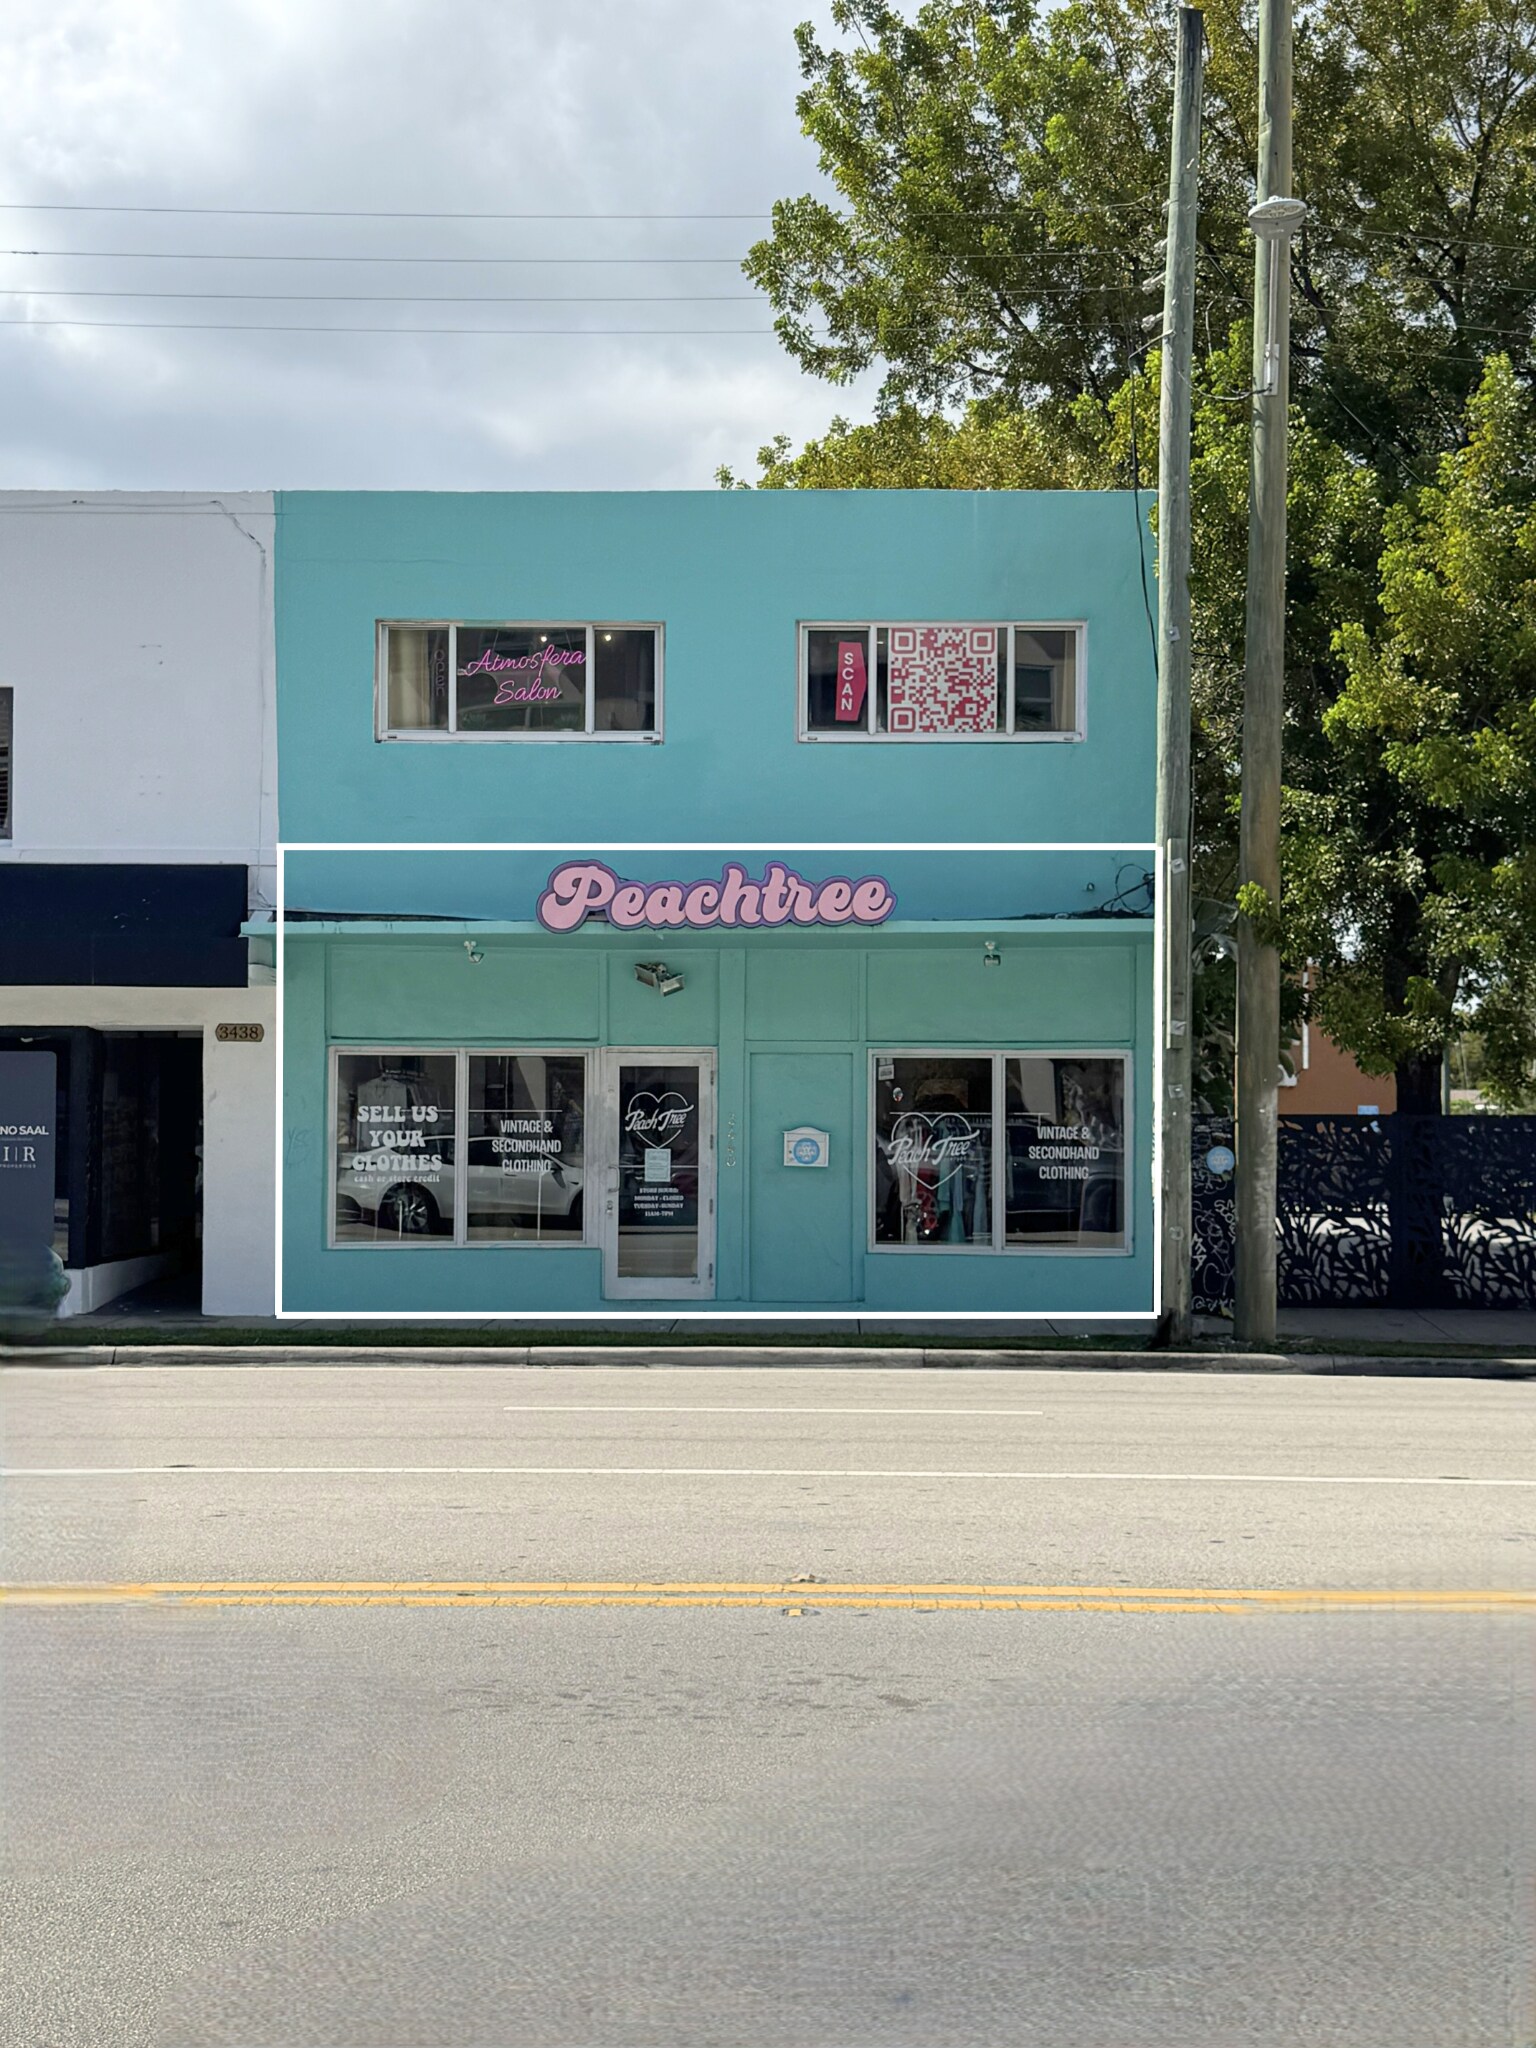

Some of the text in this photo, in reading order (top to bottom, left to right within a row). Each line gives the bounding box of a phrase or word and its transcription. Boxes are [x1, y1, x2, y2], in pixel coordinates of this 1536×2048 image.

[466, 644, 586, 677] Atmosfera
[841, 652, 854, 711] SCAN
[493, 677, 561, 704] Salon
[540, 862, 894, 932] Peachtree
[219, 1026, 259, 1039] 3438
[357, 1105, 439, 1122] SELL US
[625, 1104, 694, 1131] Peach Tree
[18, 1125, 50, 1135] SAAL
[500, 1120, 553, 1133] VINTAGE &
[1037, 1126, 1090, 1139] VINTAGE &
[369, 1130, 426, 1147] YOUR
[491, 1140, 561, 1153] SECONDHAND
[888, 1129, 980, 1165] Peach Tree
[1028, 1146, 1100, 1160] SECONDHAND
[352, 1154, 442, 1171] CLOTHES
[502, 1159, 551, 1172] CLOTHING
[1039, 1166, 1089, 1179] CLOTHING
